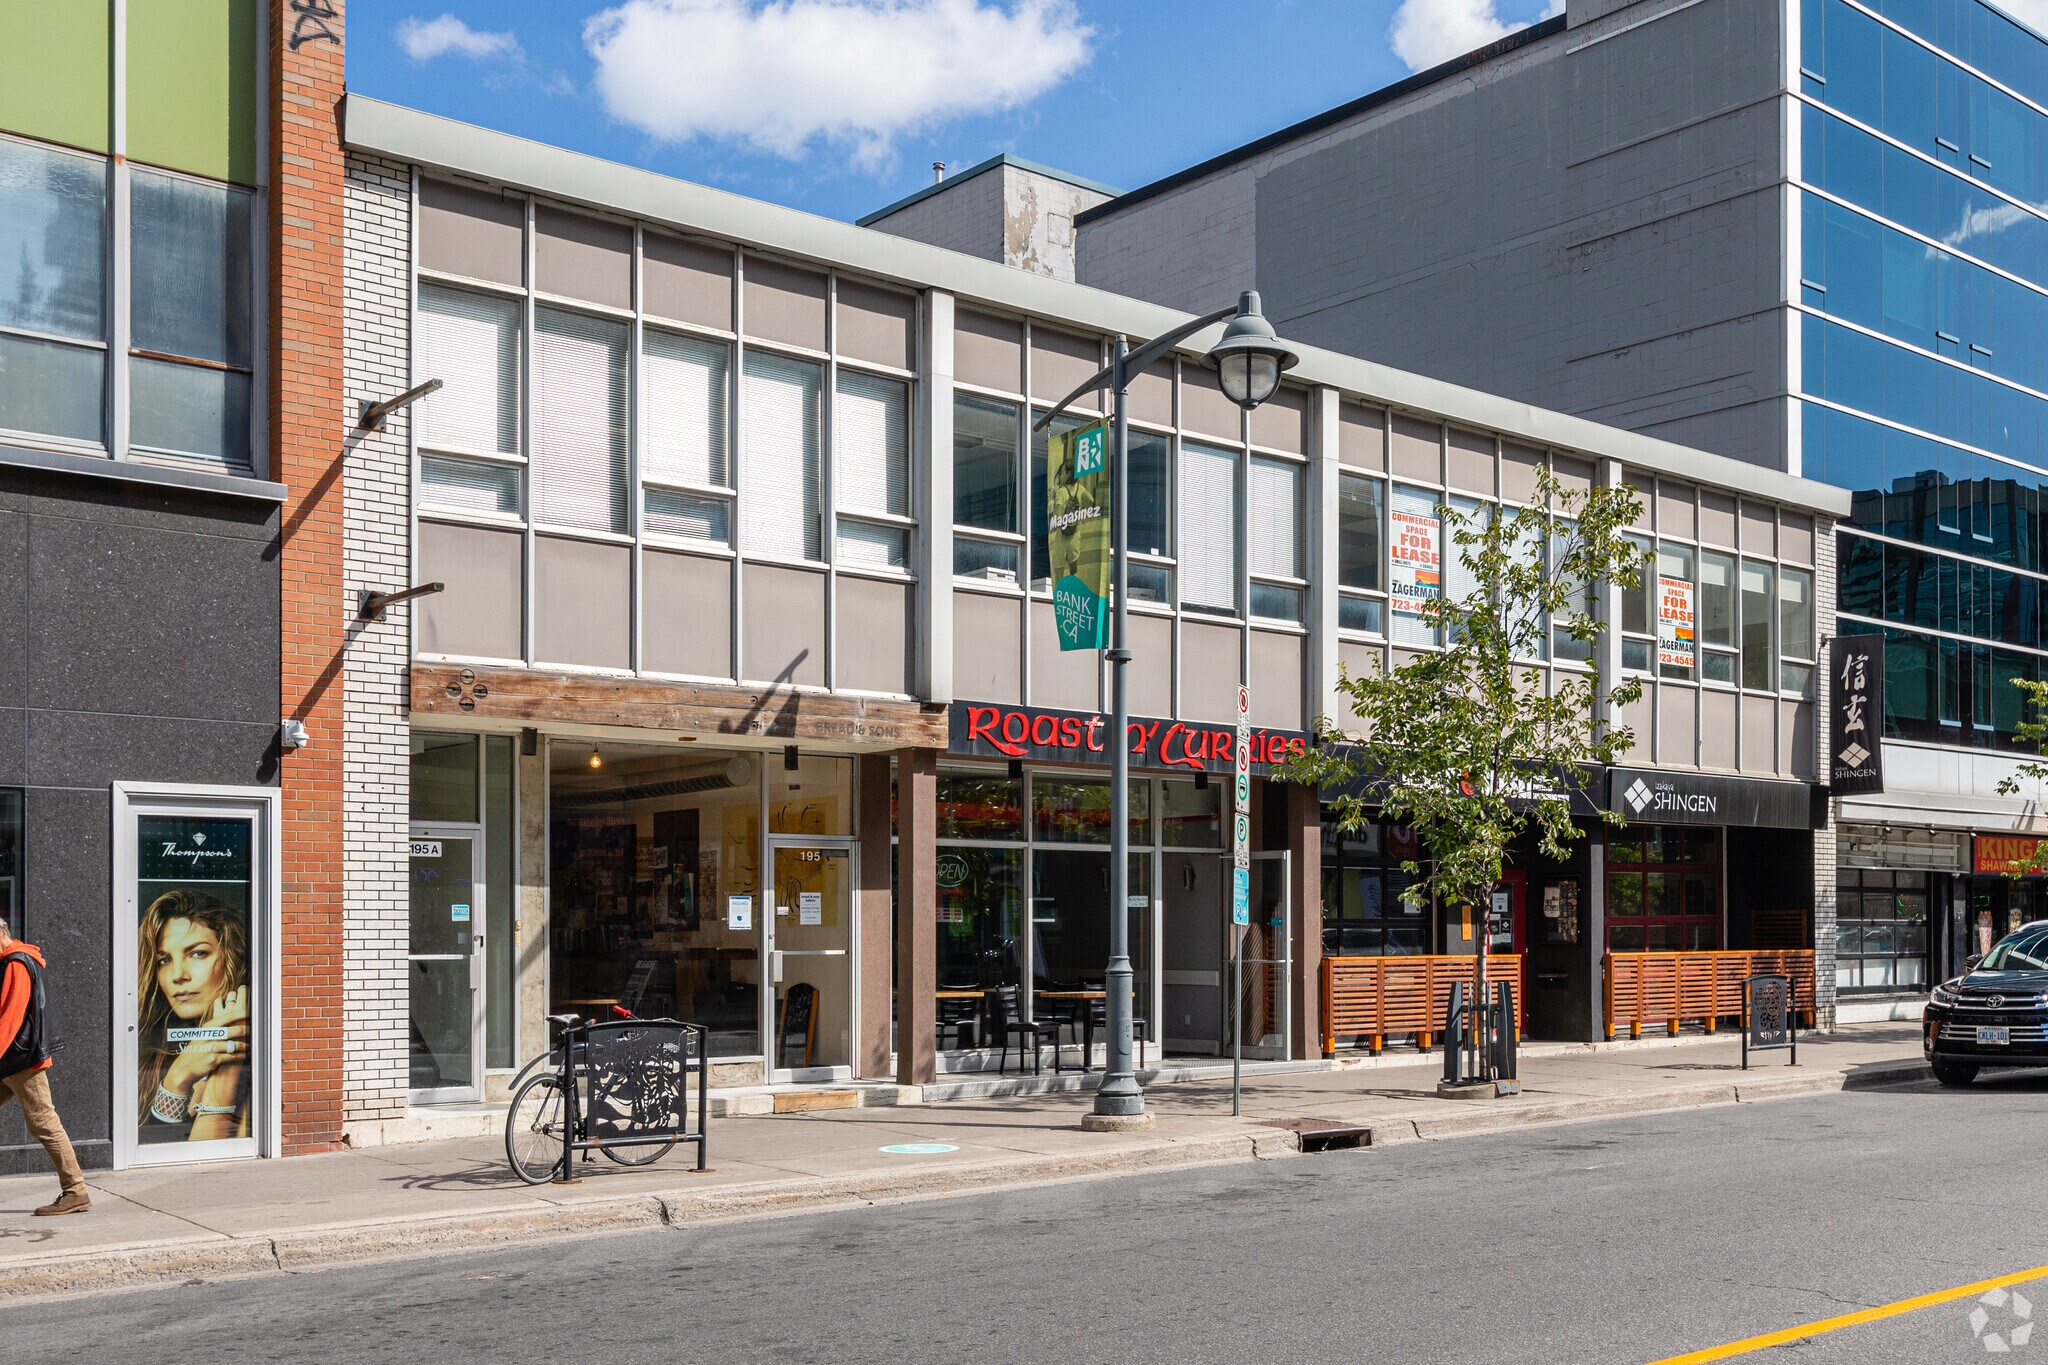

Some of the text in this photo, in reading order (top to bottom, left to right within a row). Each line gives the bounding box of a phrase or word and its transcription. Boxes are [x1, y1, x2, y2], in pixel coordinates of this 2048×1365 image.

[1391, 512, 1439, 529] COMMERCIAL
[1405, 525, 1428, 537] SPACE
[1400, 533, 1432, 550] FOR
[1391, 545, 1440, 565] LEASE
[1391, 582, 1440, 600] ZAGERMAN
[1667, 588, 1685, 598] SPACE
[1056, 590, 1091, 615] BANK
[1391, 598, 1440, 615] 723-4
[1663, 595, 1687, 609] FOR
[1056, 605, 1095, 632] STREET
[815, 721, 855, 736] BREAD
[868, 725, 901, 739] SONS
[1834, 768, 1877, 780] SHINGEN
[1654, 792, 1717, 813] SHINGEN
[161, 842, 232, 865] Thompson's
[409, 844, 439, 854] 195 A
[800, 851, 820, 861] 195
[1981, 838, 2033, 860] KING
[170, 1029, 225, 1039] COMMITTED
